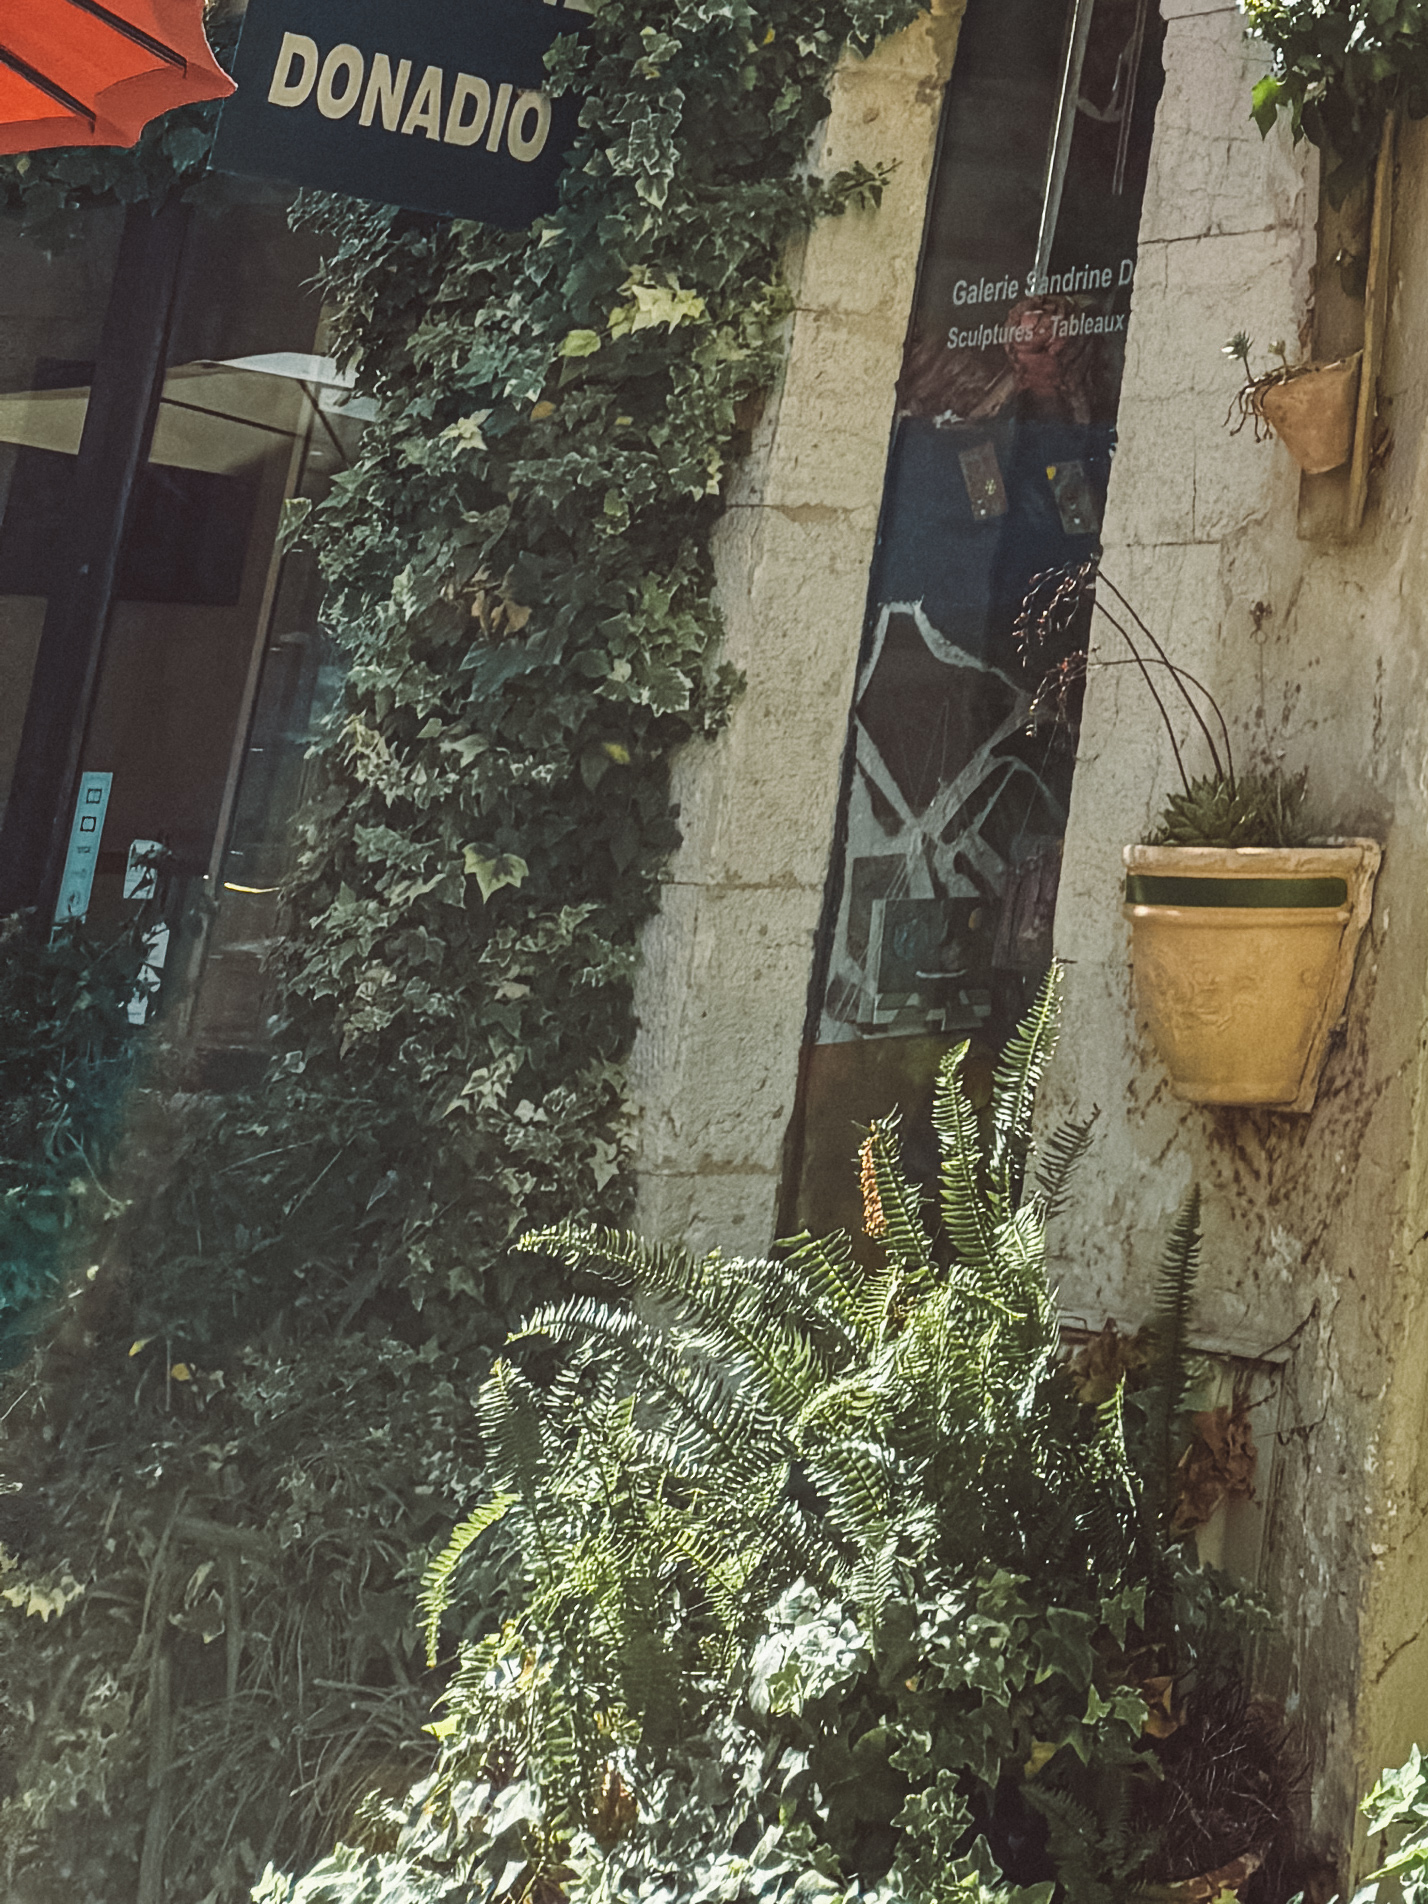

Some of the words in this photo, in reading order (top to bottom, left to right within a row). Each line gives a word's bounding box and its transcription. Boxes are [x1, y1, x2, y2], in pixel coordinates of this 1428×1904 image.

[267, 32, 552, 163] DONADIO
[952, 274, 1019, 305] Galerie
[1024, 264, 1112, 297] Sandrine
[947, 322, 1034, 351] Sculptures
[1050, 311, 1125, 338] Tableaux
